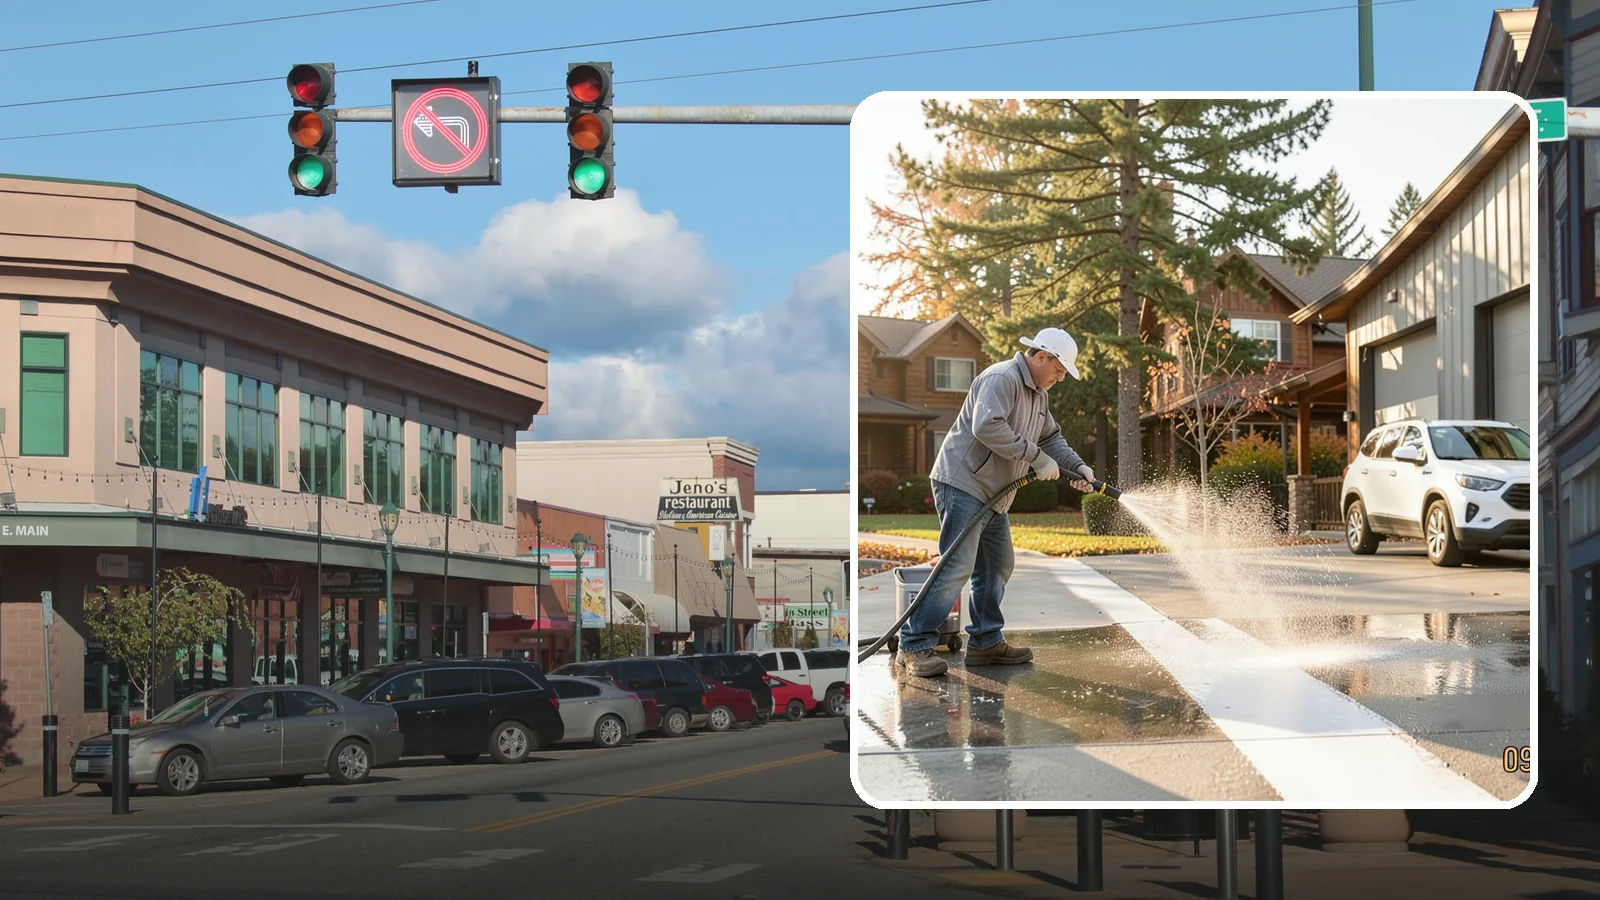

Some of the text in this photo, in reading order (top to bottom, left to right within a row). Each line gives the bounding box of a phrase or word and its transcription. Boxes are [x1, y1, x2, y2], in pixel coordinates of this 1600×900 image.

[669, 480, 727, 495] Jeno's
[665, 496, 731, 509] restaurant
[658, 509, 681, 519] Italian
[685, 509, 714, 519] American
[714, 509, 737, 519] Cuisine
[2, 525, 49, 536] E. MAIN
[797, 607, 829, 617] Street
[791, 619, 824, 627] lass
